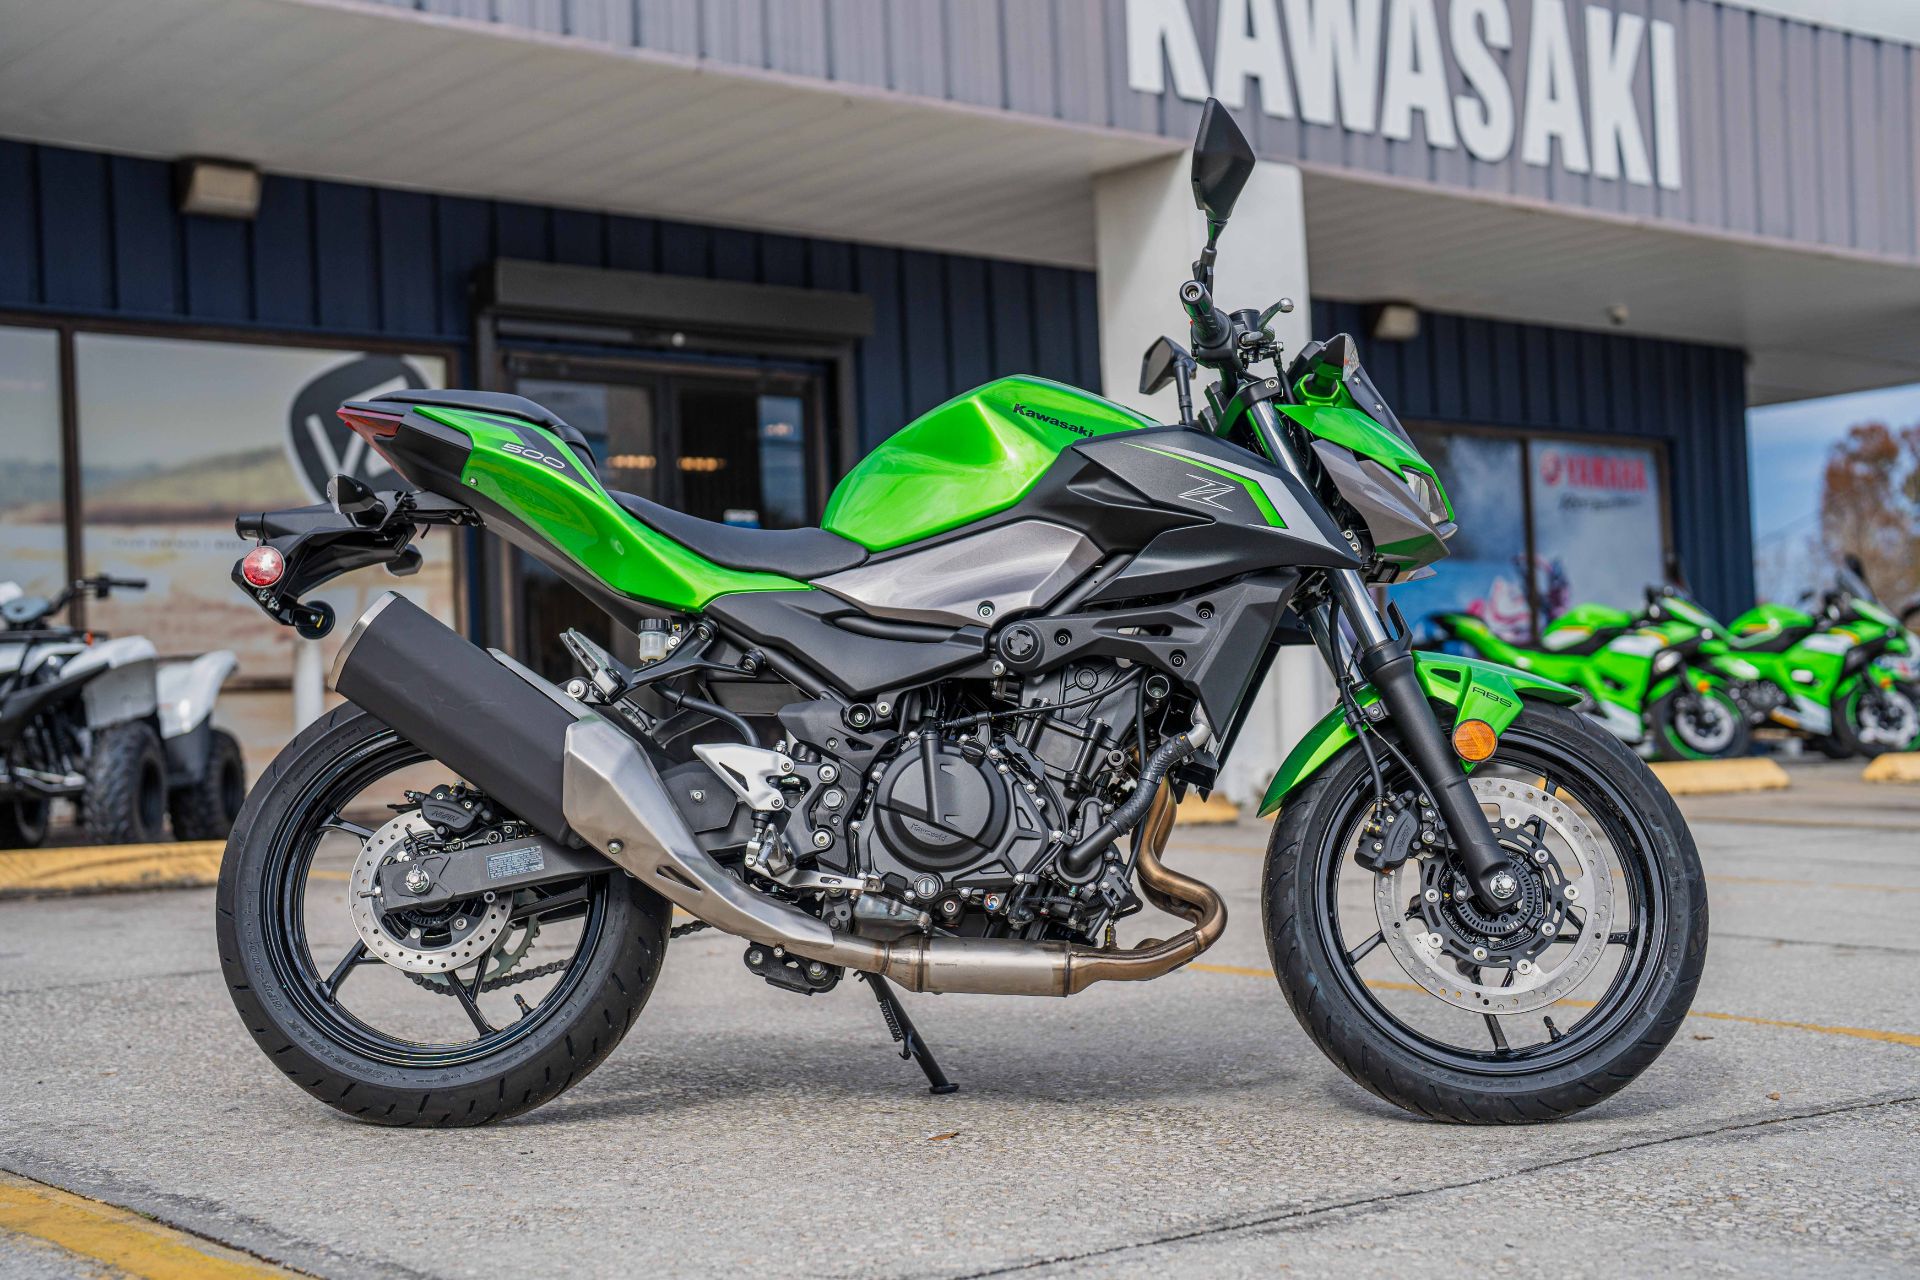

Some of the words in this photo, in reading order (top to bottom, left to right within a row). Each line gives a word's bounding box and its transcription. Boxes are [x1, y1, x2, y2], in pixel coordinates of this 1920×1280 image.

[1127, 0, 1682, 189] KAWASAKI
[1013, 403, 1095, 437] Kawasaki
[501, 442, 566, 469] 500
[1178, 473, 1236, 512] Z
[1472, 686, 1513, 708] ABS
